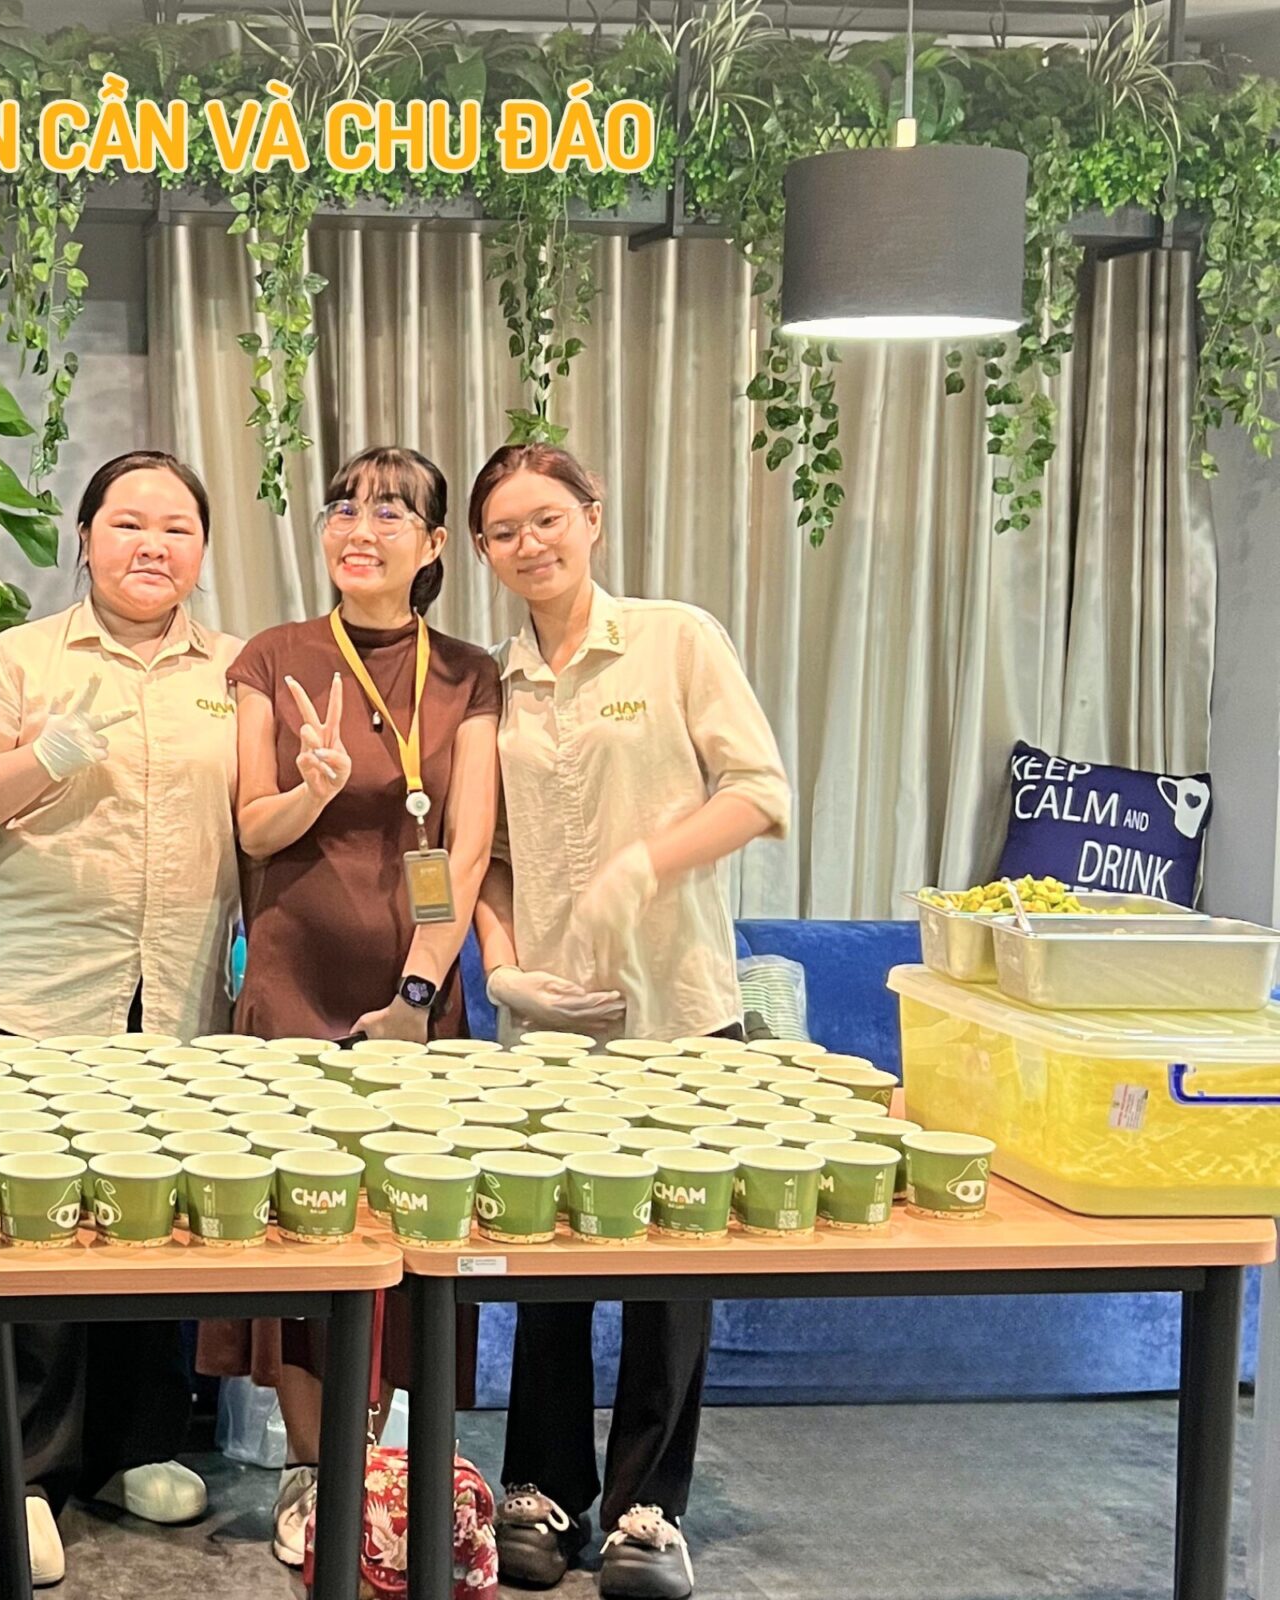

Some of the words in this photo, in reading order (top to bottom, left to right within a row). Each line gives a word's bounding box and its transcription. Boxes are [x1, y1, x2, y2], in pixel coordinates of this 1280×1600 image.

[600, 699, 646, 717] CHAM
[1012, 755, 1092, 782] KEEP
[1015, 784, 1119, 827] CALM
[1123, 808, 1149, 832] AND
[1077, 840, 1174, 900] DRINK
[291, 1187, 347, 1208] CHAM
[653, 1181, 706, 1205] CHAM
